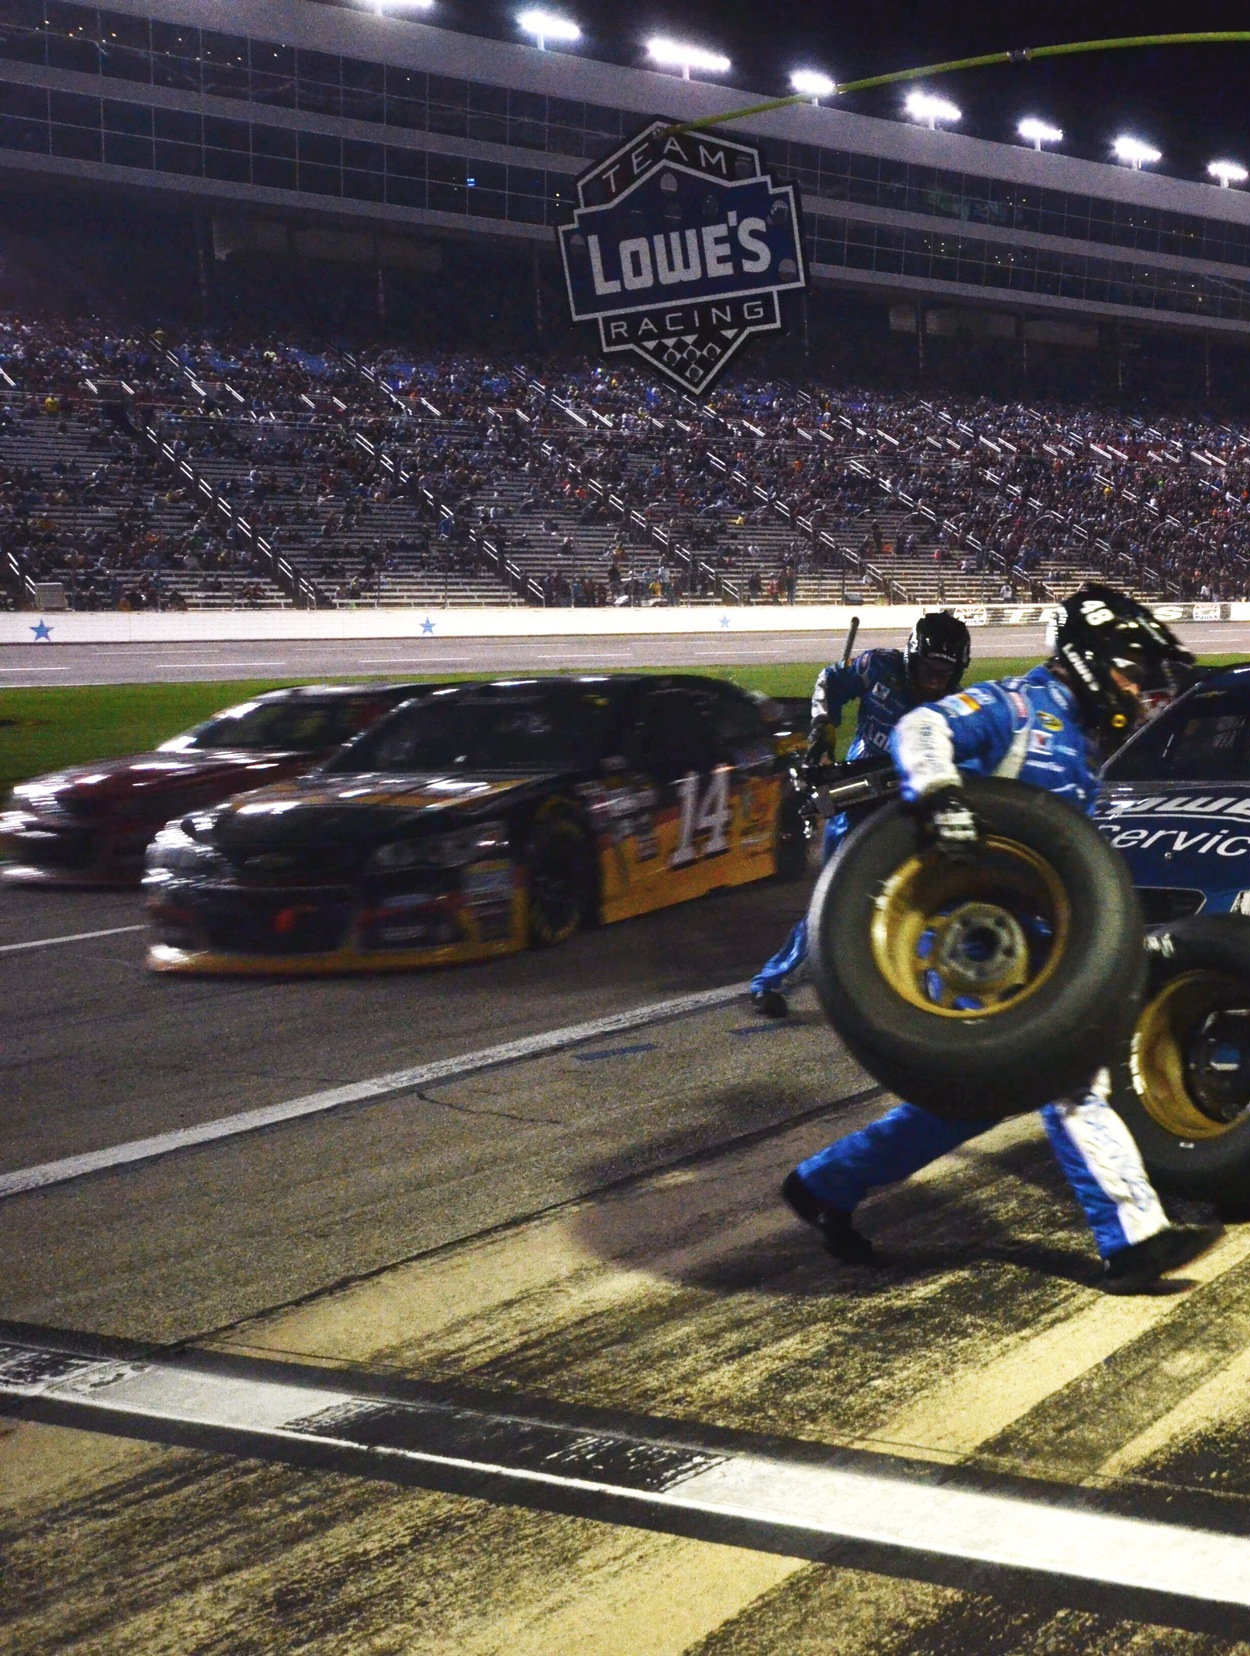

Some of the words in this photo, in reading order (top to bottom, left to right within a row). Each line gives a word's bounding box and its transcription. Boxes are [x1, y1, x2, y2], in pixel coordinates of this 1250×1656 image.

[602, 136, 727, 193] TEAM
[587, 210, 772, 296] LOWE'S
[610, 301, 764, 340] RACING
[1080, 600, 1116, 626] 48
[667, 764, 731, 867] 14
